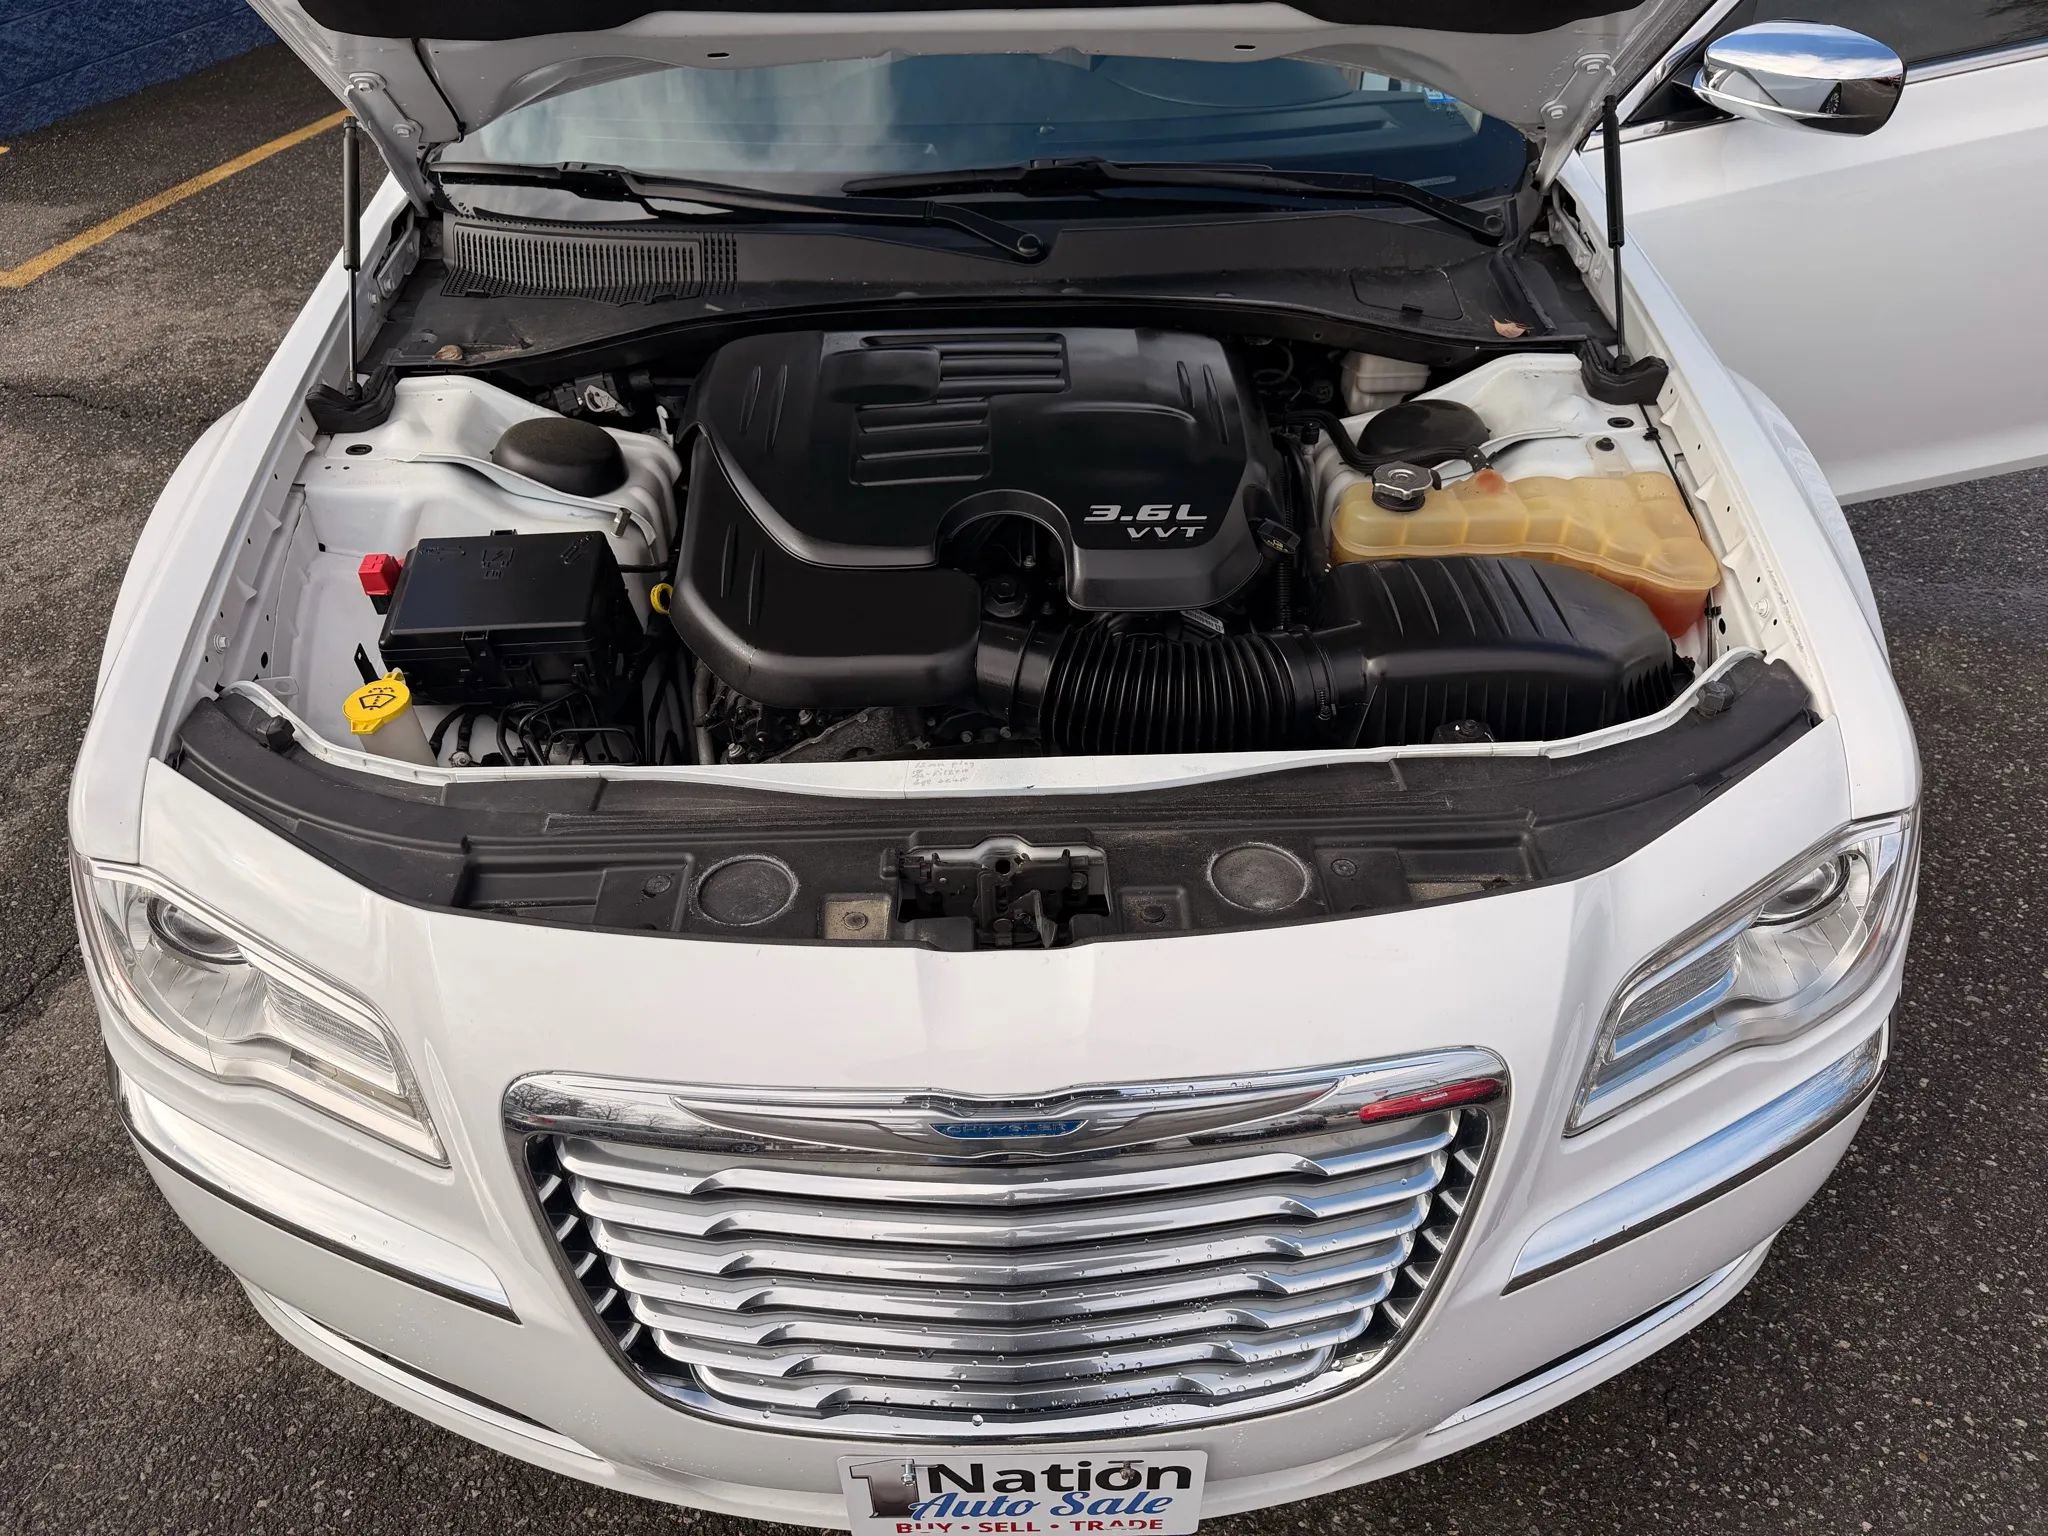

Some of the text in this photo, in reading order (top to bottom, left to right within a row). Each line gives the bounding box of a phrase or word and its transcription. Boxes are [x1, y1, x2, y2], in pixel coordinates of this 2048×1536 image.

[1083, 504, 1208, 522] 3.6L
[1126, 526, 1205, 539] VVT
[927, 1460, 1192, 1494] Nation
[907, 1491, 1173, 1521] Auto Sale
[895, 1518, 1164, 1534] BUY SELL TRADE
